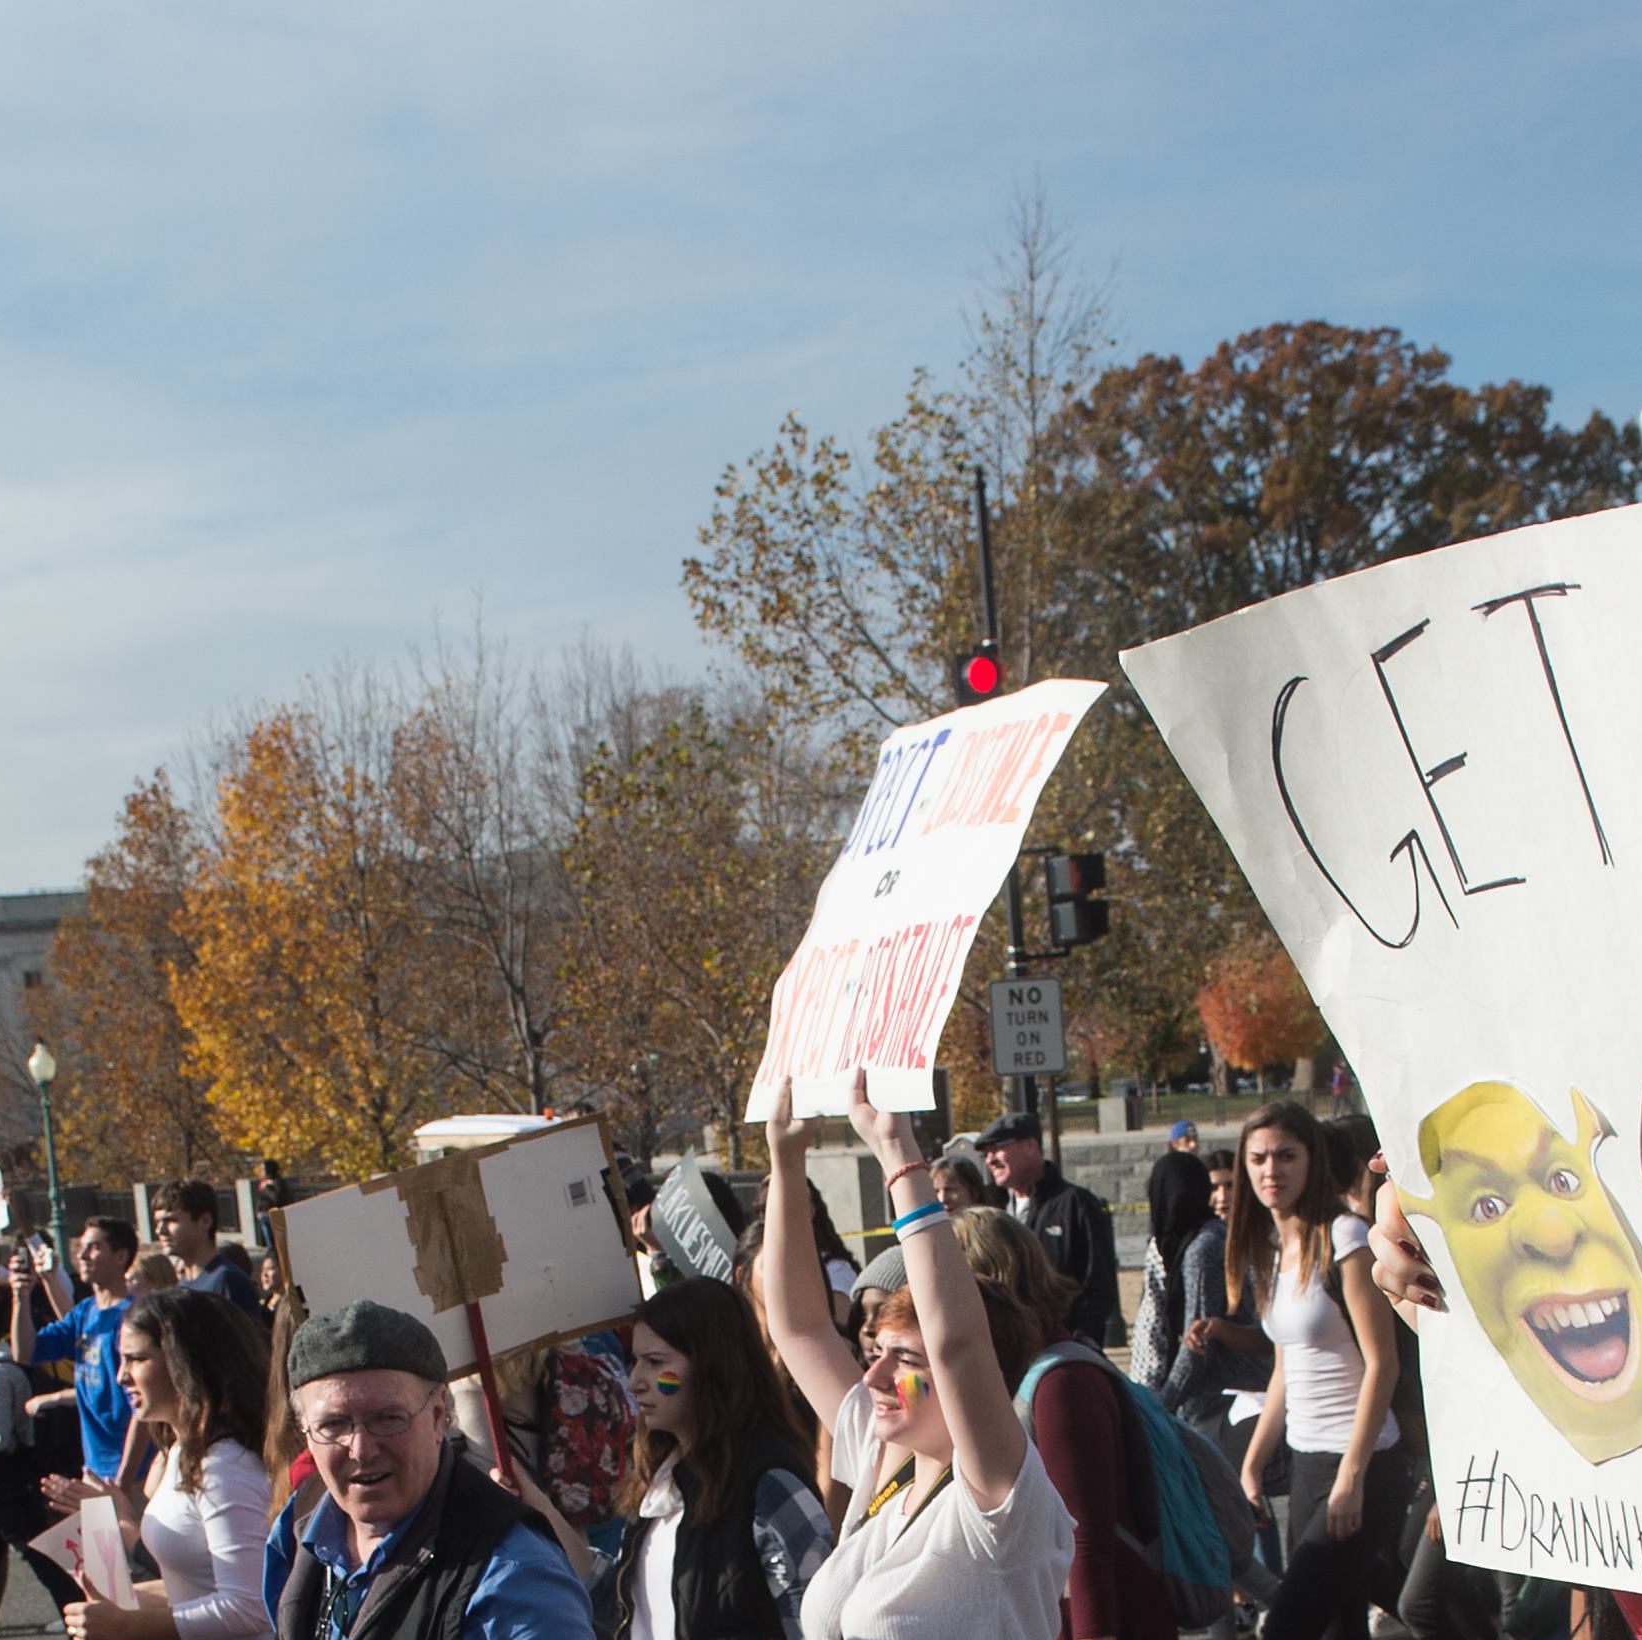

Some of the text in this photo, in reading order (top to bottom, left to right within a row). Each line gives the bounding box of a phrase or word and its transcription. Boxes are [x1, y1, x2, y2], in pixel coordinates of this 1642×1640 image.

[1269, 582, 1616, 951] GET
[873, 869, 901, 898] OR
[1008, 986, 1042, 1006] NO
[1006, 1010, 1049, 1027] TURN
[1017, 1031, 1041, 1047] ON
[1013, 1051, 1047, 1067] RED
[868, 1480, 899, 1517] Nikon
